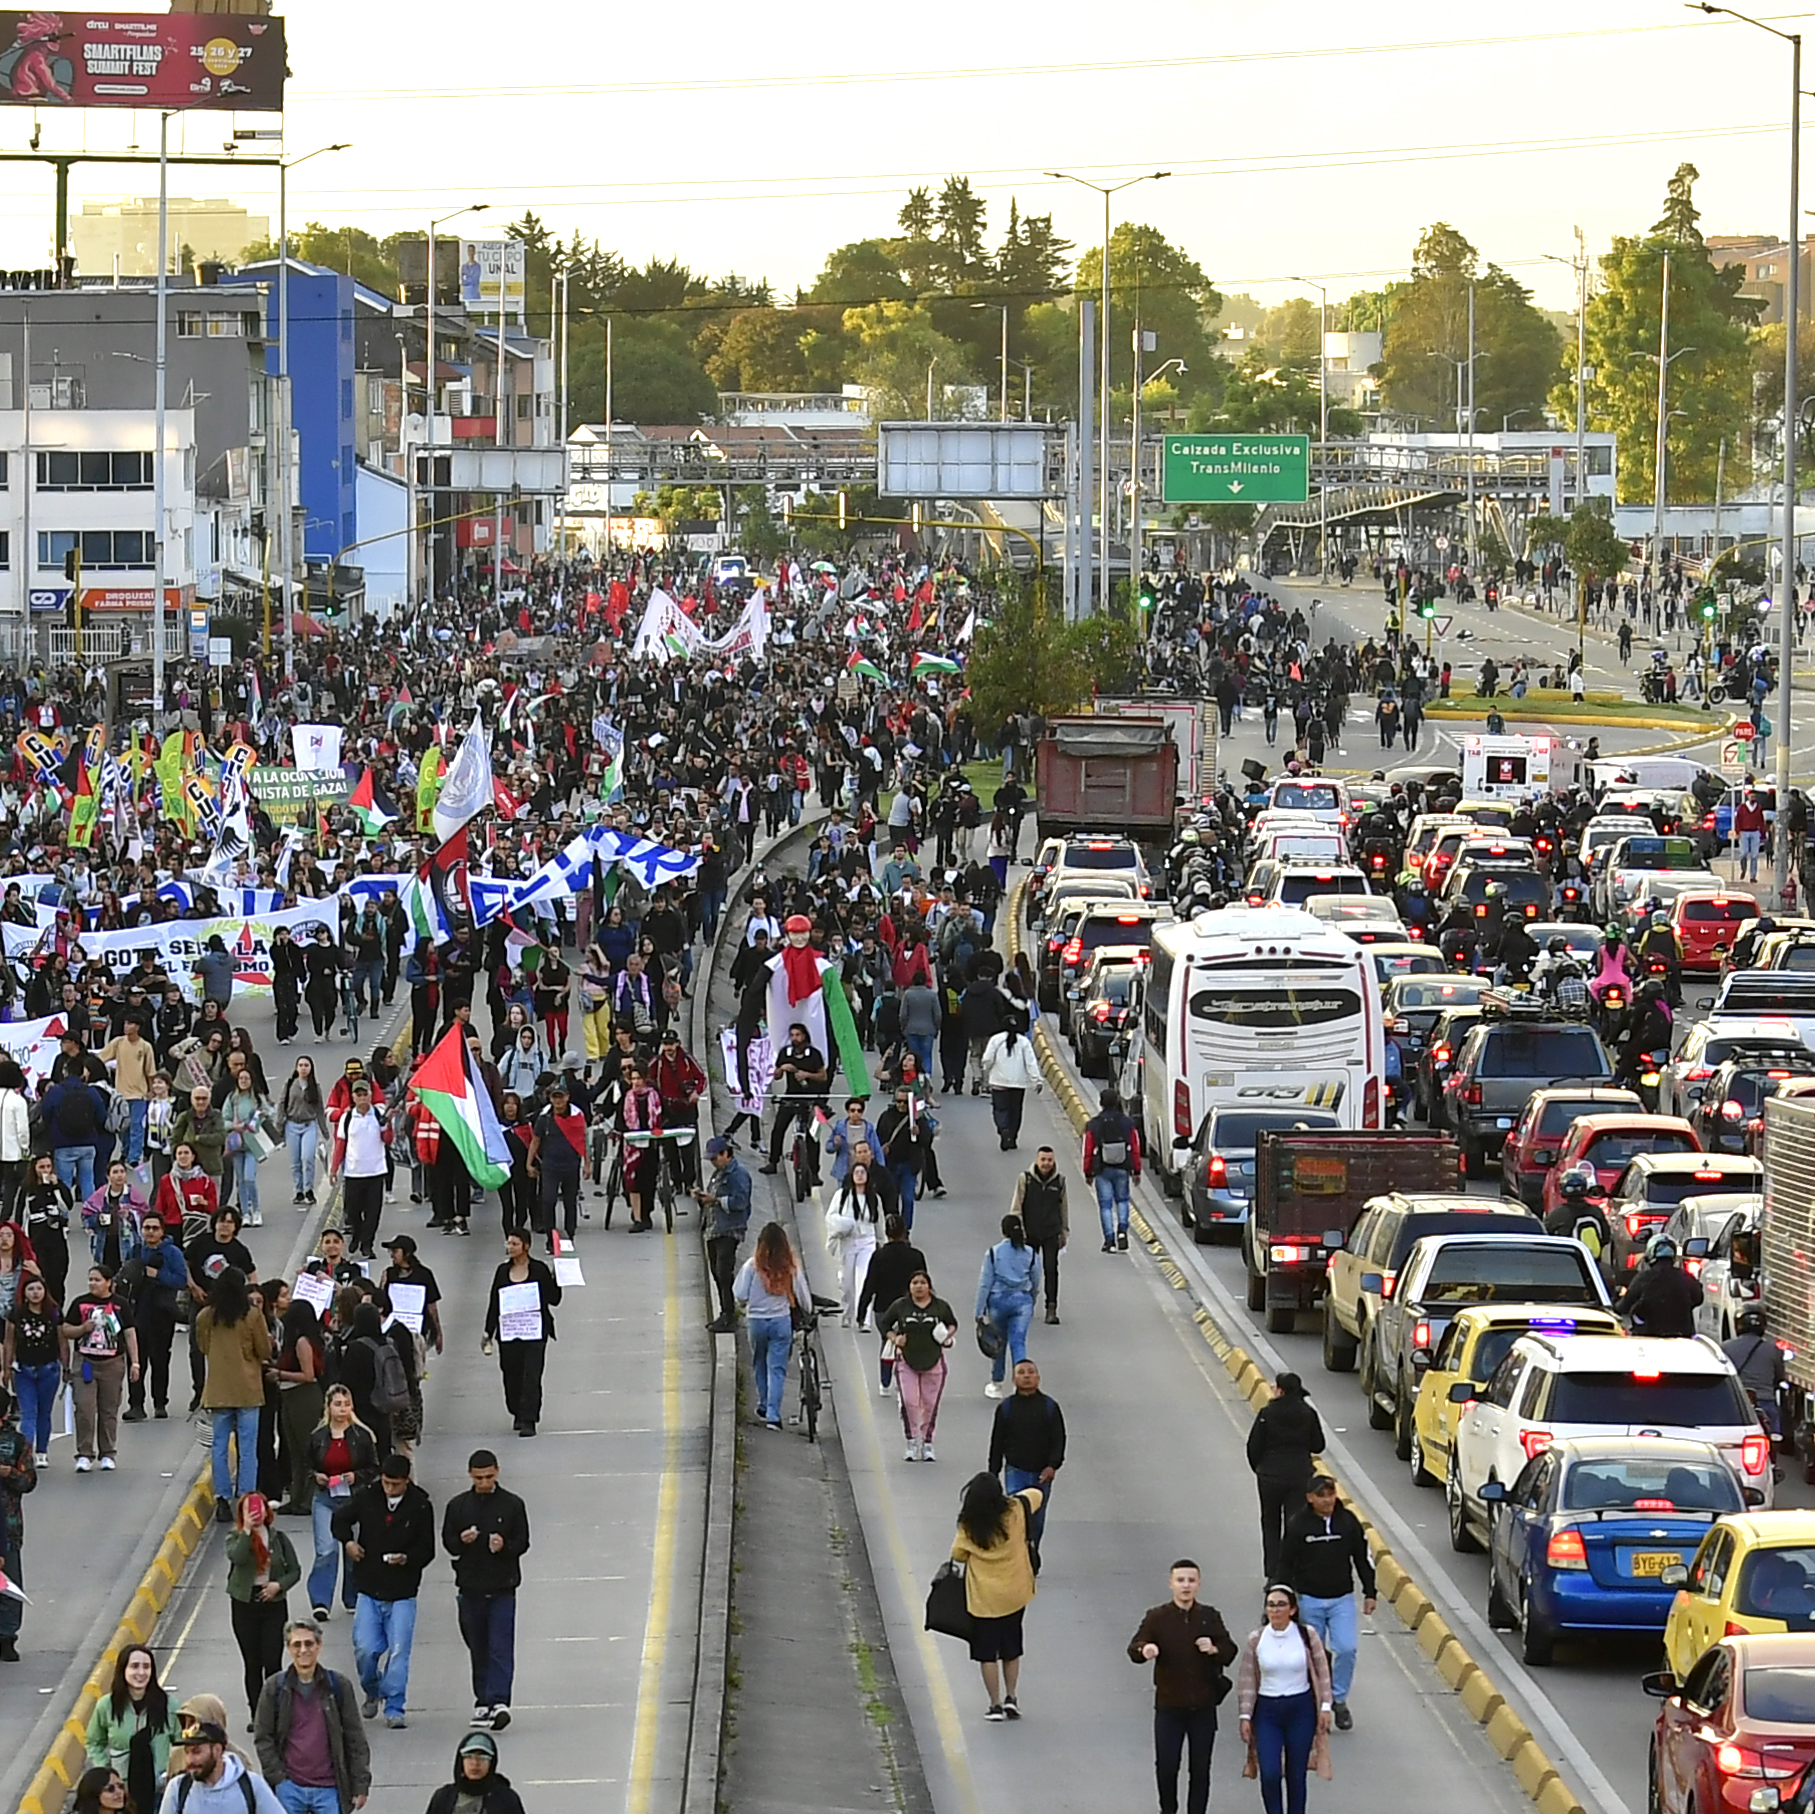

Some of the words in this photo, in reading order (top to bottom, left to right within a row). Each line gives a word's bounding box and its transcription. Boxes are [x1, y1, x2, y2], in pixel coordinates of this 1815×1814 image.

[83, 43, 163, 61] SMARTFILMS
[87, 60, 130, 75] SUMMIT
[132, 61, 157, 76] FEST
[1171, 443, 1227, 456] Calzada
[1232, 443, 1301, 456] Exclusiva
[1190, 461, 1281, 475] TransMilenio
[105, 591, 155, 600] DROGUERÍ
[94, 600, 126, 608] FARMA
[1736, 727, 1754, 738] PARE
[263, 771, 279, 783] LA
[252, 786, 291, 800] NISTA
[293, 785, 312, 798] DE
[313, 781, 348, 796] GAZA!
[236, 940, 268, 958] LA
